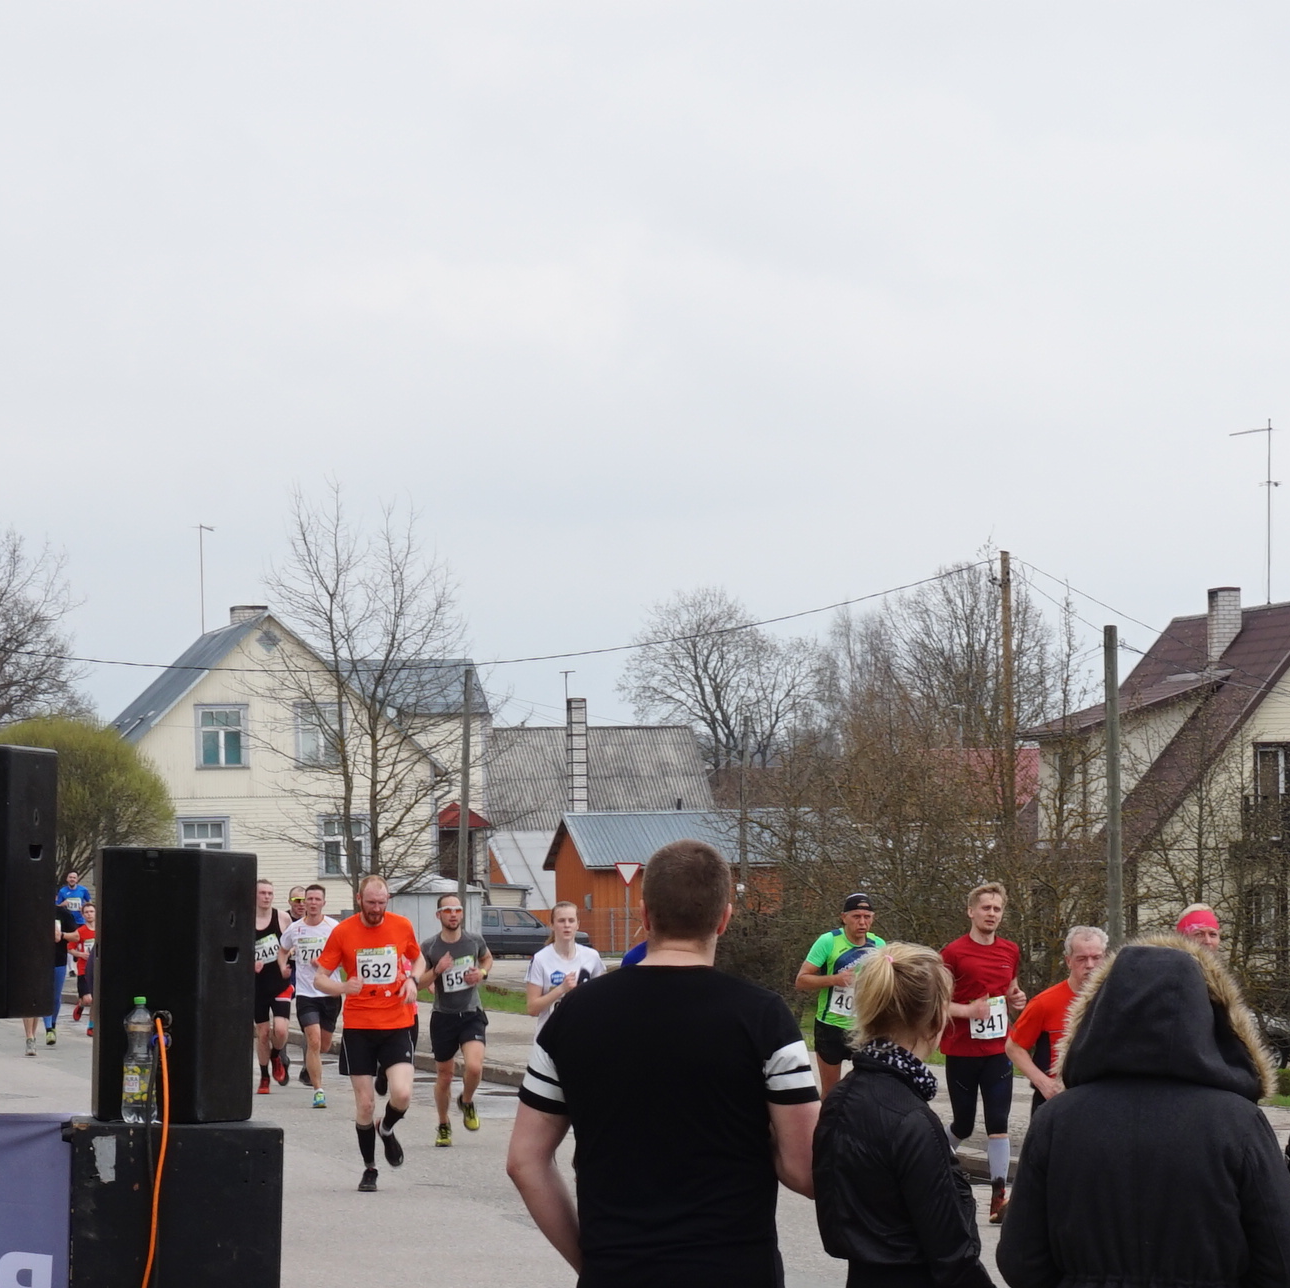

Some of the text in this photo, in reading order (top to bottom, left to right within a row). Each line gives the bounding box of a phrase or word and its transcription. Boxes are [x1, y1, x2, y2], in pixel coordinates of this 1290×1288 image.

[361, 963, 391, 978] 632
[835, 994, 854, 1010] 40
[974, 1014, 1003, 1033] 341
